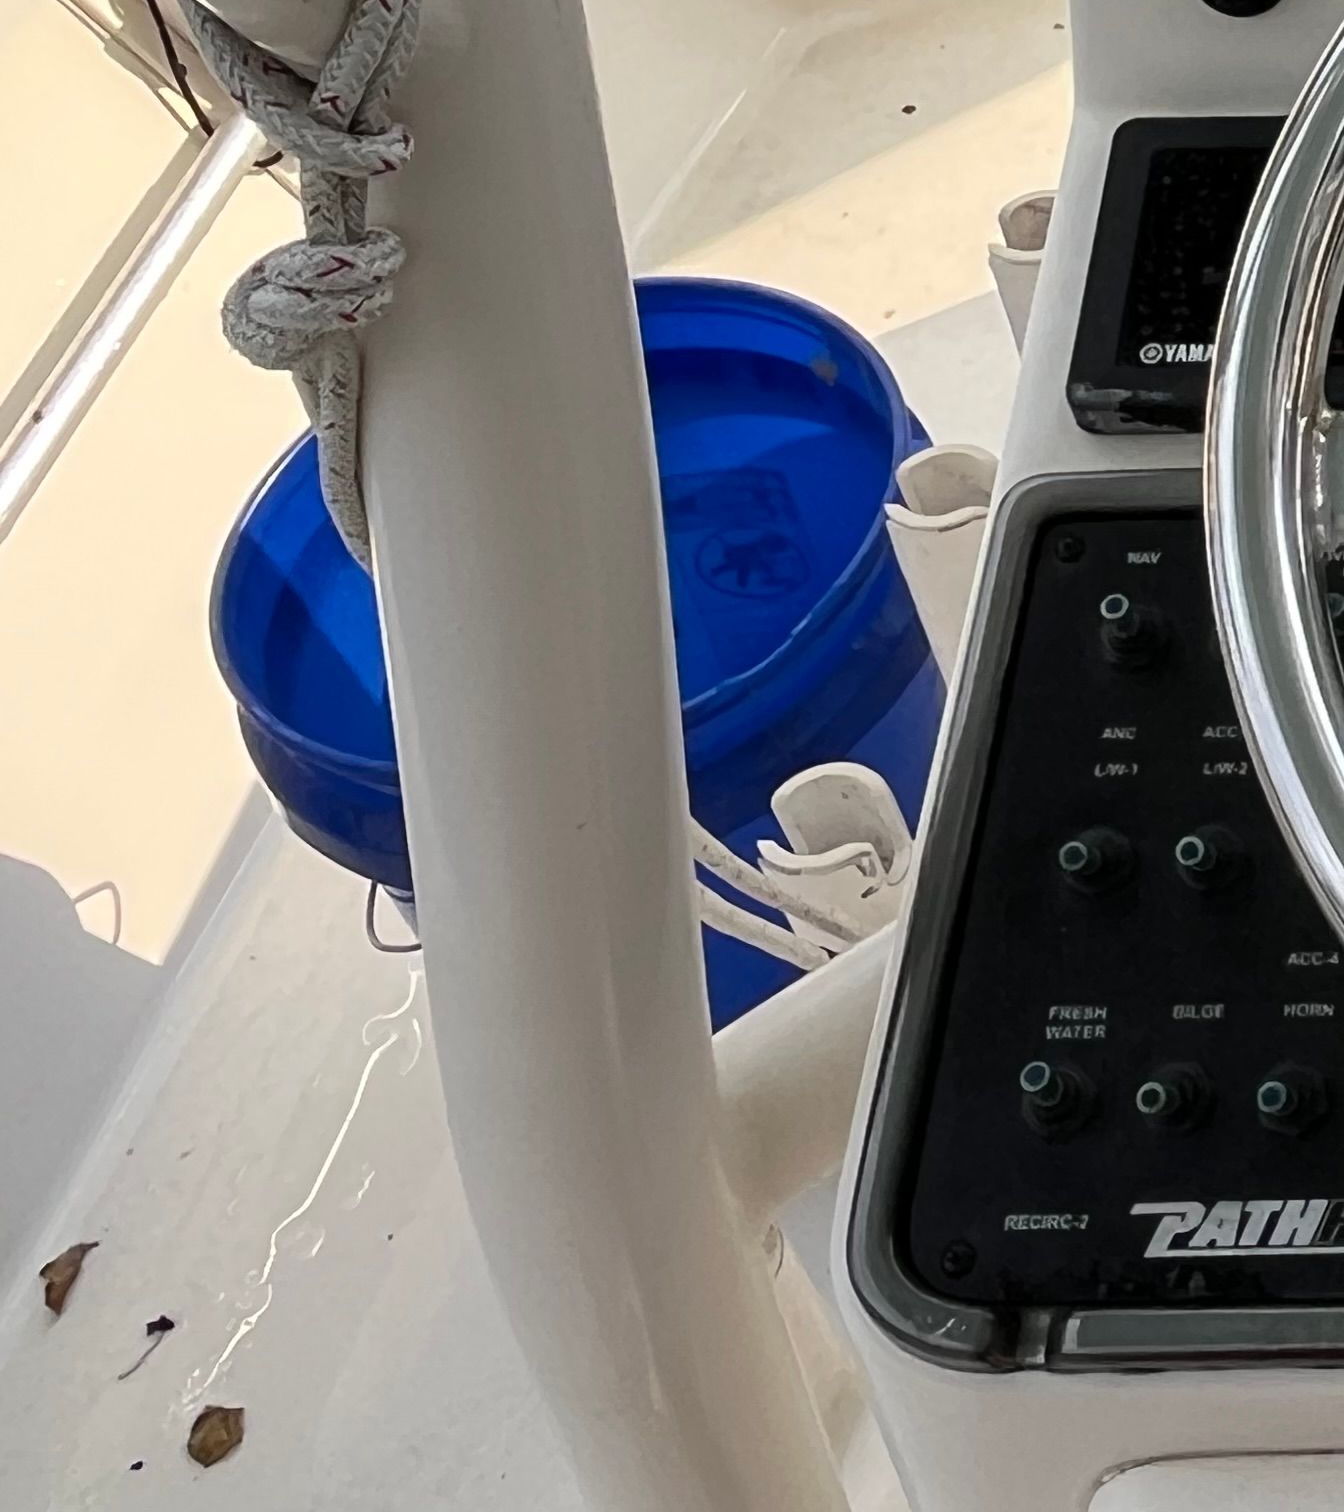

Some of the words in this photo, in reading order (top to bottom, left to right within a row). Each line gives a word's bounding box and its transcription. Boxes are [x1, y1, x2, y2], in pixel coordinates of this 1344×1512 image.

[1164, 343, 1214, 363] YAMA
[1127, 550, 1163, 565] NAV
[1100, 726, 1138, 739] ANC
[1202, 725, 1239, 738] ACC
[1287, 951, 1340, 966] ACC-4
[1048, 1005, 1108, 1021] FRESH
[1282, 1003, 1335, 1017] HORN
[1045, 1024, 1107, 1040] WATER
